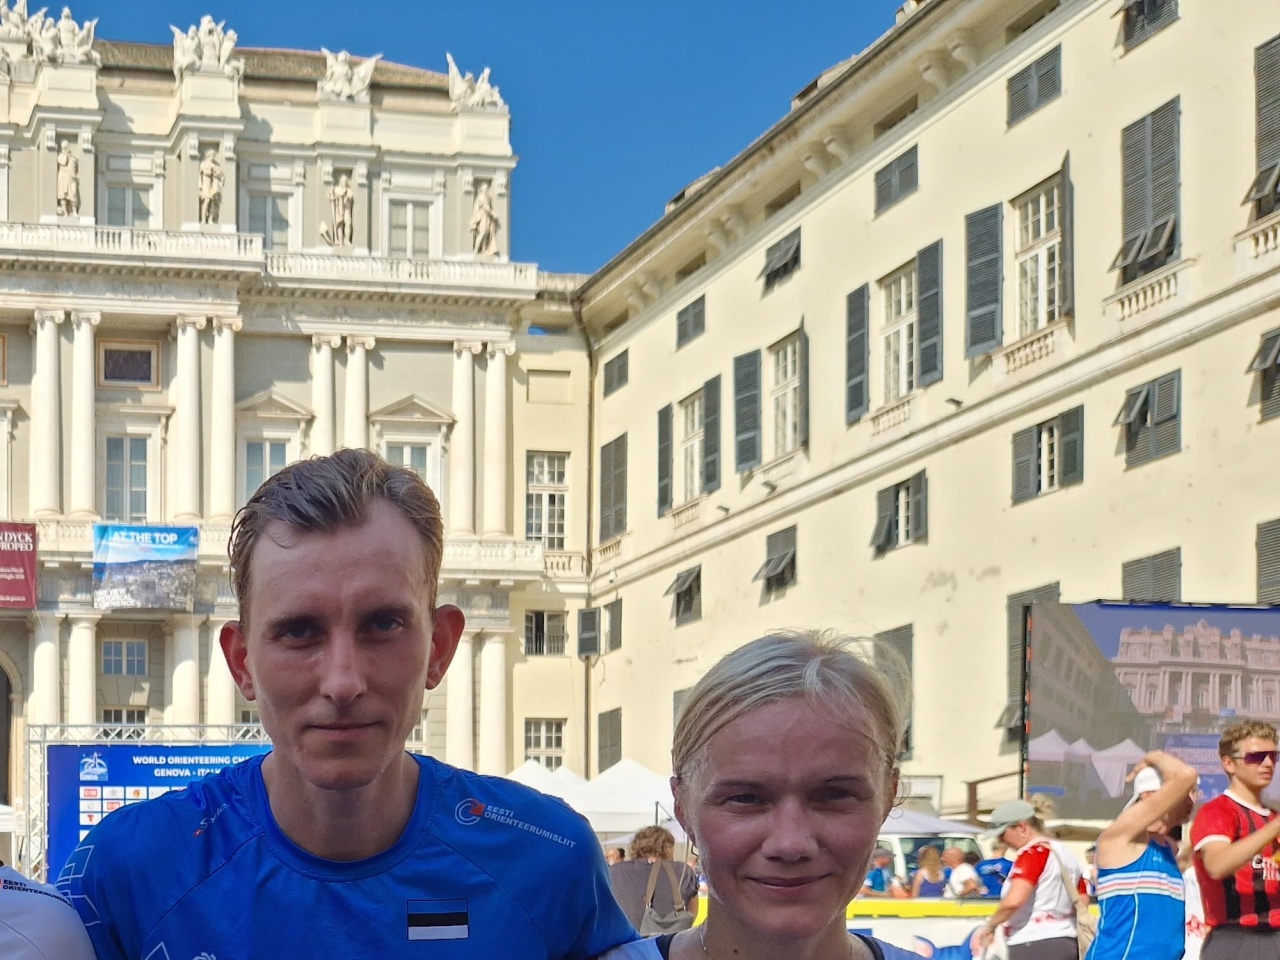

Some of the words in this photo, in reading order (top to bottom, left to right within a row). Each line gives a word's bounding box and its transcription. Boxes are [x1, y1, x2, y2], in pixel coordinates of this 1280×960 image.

[113, 531, 127, 541] AT
[129, 532, 152, 542] THE
[153, 533, 178, 544] TOP
[133, 756, 166, 764] WORLD
[168, 756, 230, 765] ORIENTEERING
[154, 769, 191, 777] GENOVA
[487, 805, 513, 817] EESTI
[484, 812, 576, 848] ORIENTEERUMISLIIT
[3, 879, 27, 888] EESTI
